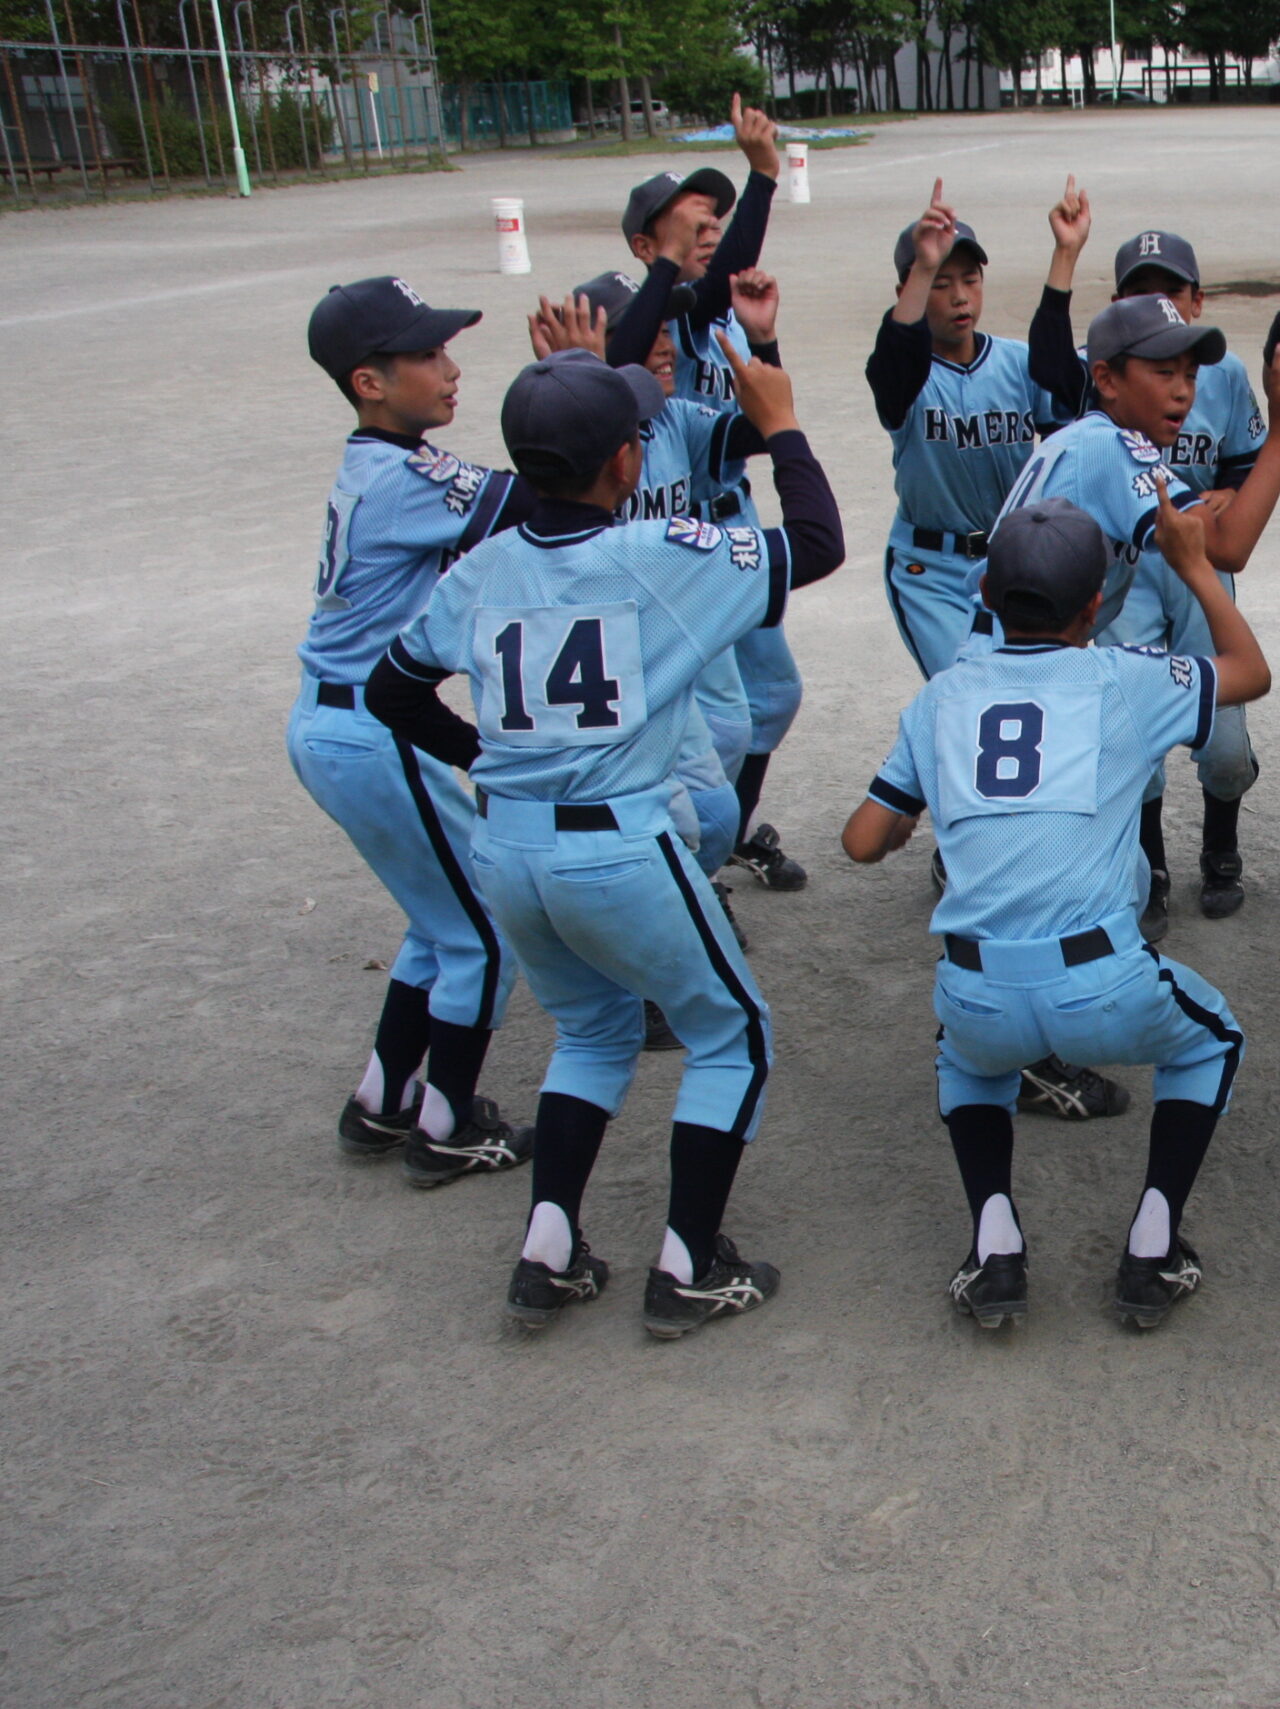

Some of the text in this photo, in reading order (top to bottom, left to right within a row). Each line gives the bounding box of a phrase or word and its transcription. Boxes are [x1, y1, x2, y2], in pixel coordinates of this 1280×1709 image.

[1138, 232, 1162, 256] H
[1156, 298, 1189, 327] H
[923, 406, 1036, 450] HMERS
[493, 616, 622, 733] 14
[973, 699, 1046, 800] 8
